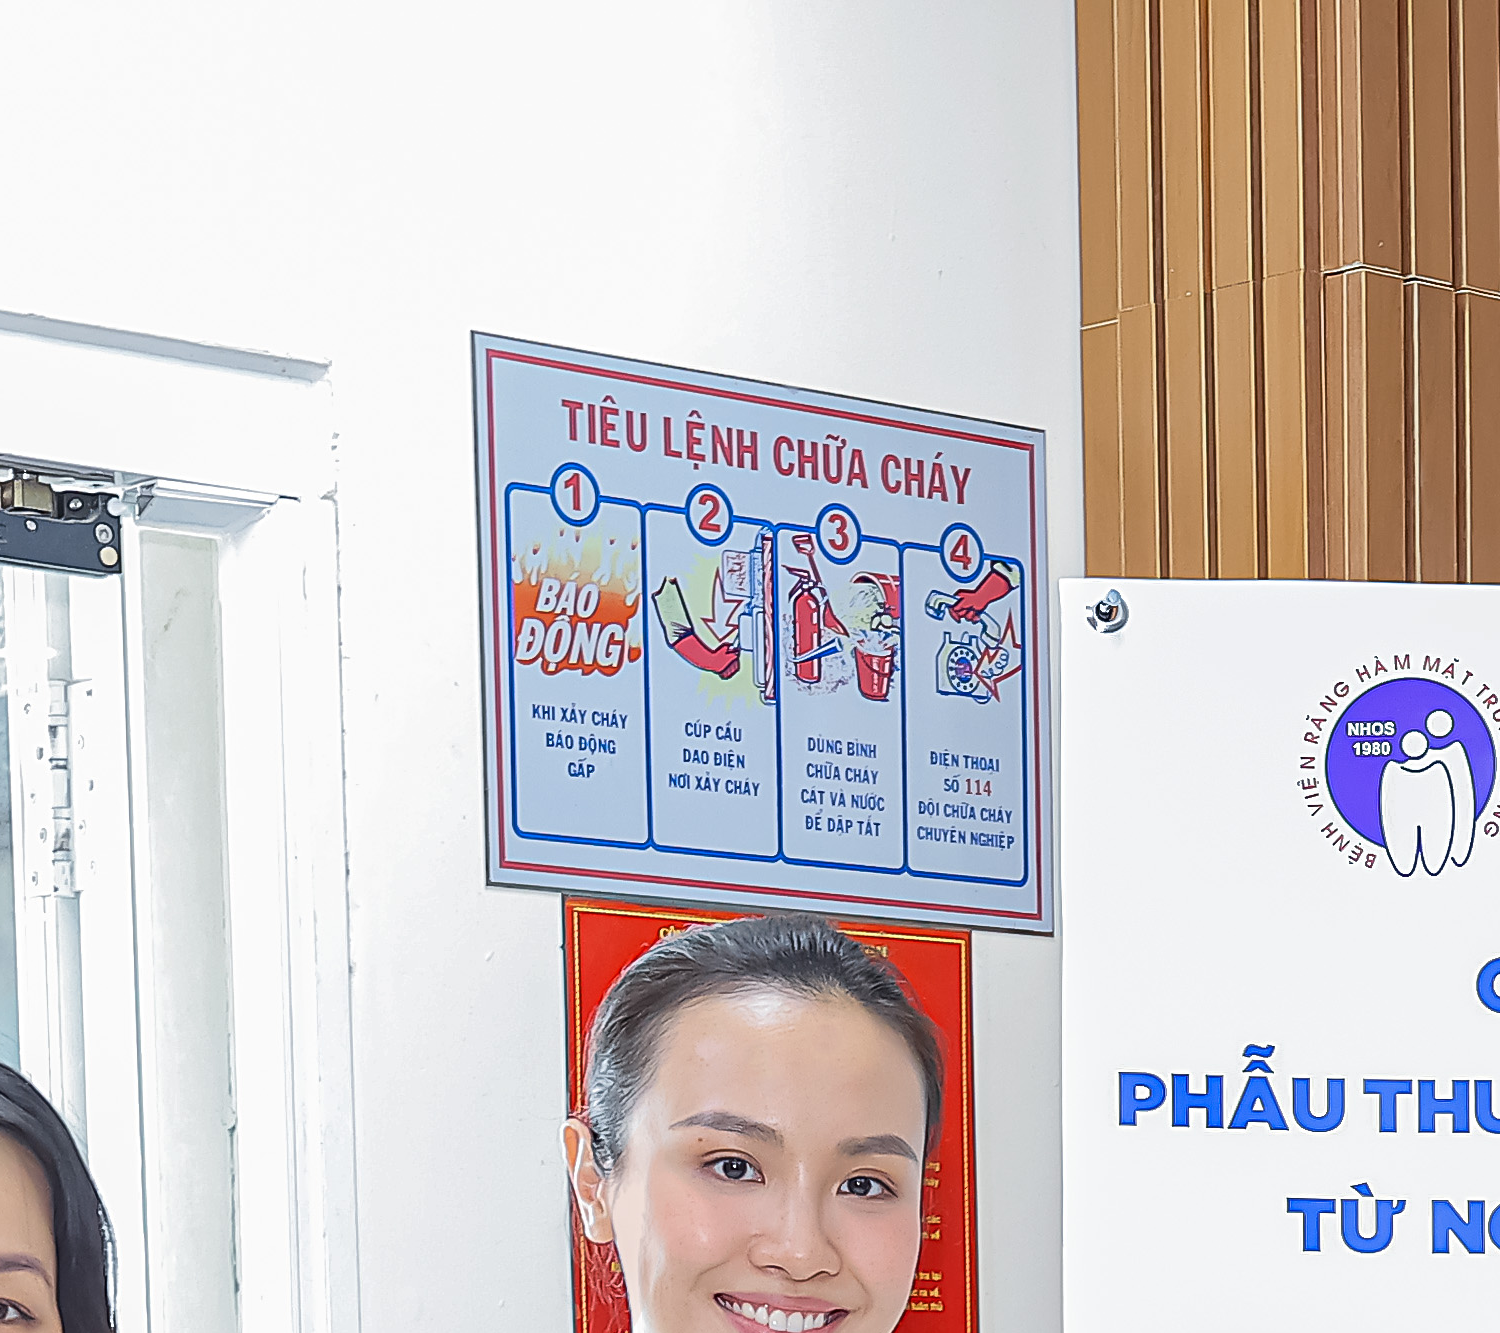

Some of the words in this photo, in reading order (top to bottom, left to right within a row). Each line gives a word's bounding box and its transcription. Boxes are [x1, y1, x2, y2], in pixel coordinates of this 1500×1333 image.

[562, 395, 647, 452] TIÊU
[663, 410, 758, 471] LỆNH
[773, 434, 868, 489] CHỮA
[881, 452, 971, 504] CHÁY
[564, 473, 581, 511] 1
[699, 494, 721, 532] 2
[827, 514, 849, 550] 3
[950, 534, 972, 570] 4
[536, 571, 600, 619] BÁO
[516, 615, 624, 672] ĐỘNG
[1355, 654, 1411, 683] HÀM
[1422, 656, 1474, 686] MẶT
[532, 704, 555, 720] KHI
[560, 702, 587, 725] XẢY
[592, 709, 627, 729] CHÁY
[1303, 681, 1350, 746] RĂNG
[546, 730, 574, 749] BÁO
[579, 734, 616, 755] ĐỘNG
[685, 719, 711, 739] CÚP
[1347, 721, 1396, 737] NHOS
[683, 748, 709, 765] DAO
[714, 750, 745, 771] ĐIỆN
[930, 749, 959, 770] ĐIỆN
[963, 755, 999, 775] THOẠI
[1352, 741, 1391, 757] 1980
[568, 758, 595, 778] GẤP
[807, 761, 840, 781] CHỮA
[845, 766, 878, 785] CHÁY
[669, 773, 690, 790] NƠI
[695, 771, 721, 793] XẢY
[725, 778, 760, 796] CHÁY
[801, 786, 825, 805] CÁT
[944, 774, 960, 793] SỐ
[965, 779, 992, 796] 114
[1297, 755, 1324, 817] VIỆN
[918, 798, 939, 818] ĐỘI
[944, 802, 976, 821] CHỮA
[980, 806, 1012, 824] CHÁY
[828, 815, 853, 837] DẬP
[917, 826, 965, 845] CHUYÊN
[970, 831, 1014, 850] NGHIỆP
[1321, 821, 1378, 870] BỆNH
[1118, 1044, 1345, 1132] PHẪU
[1286, 1182, 1406, 1253] TỪ
